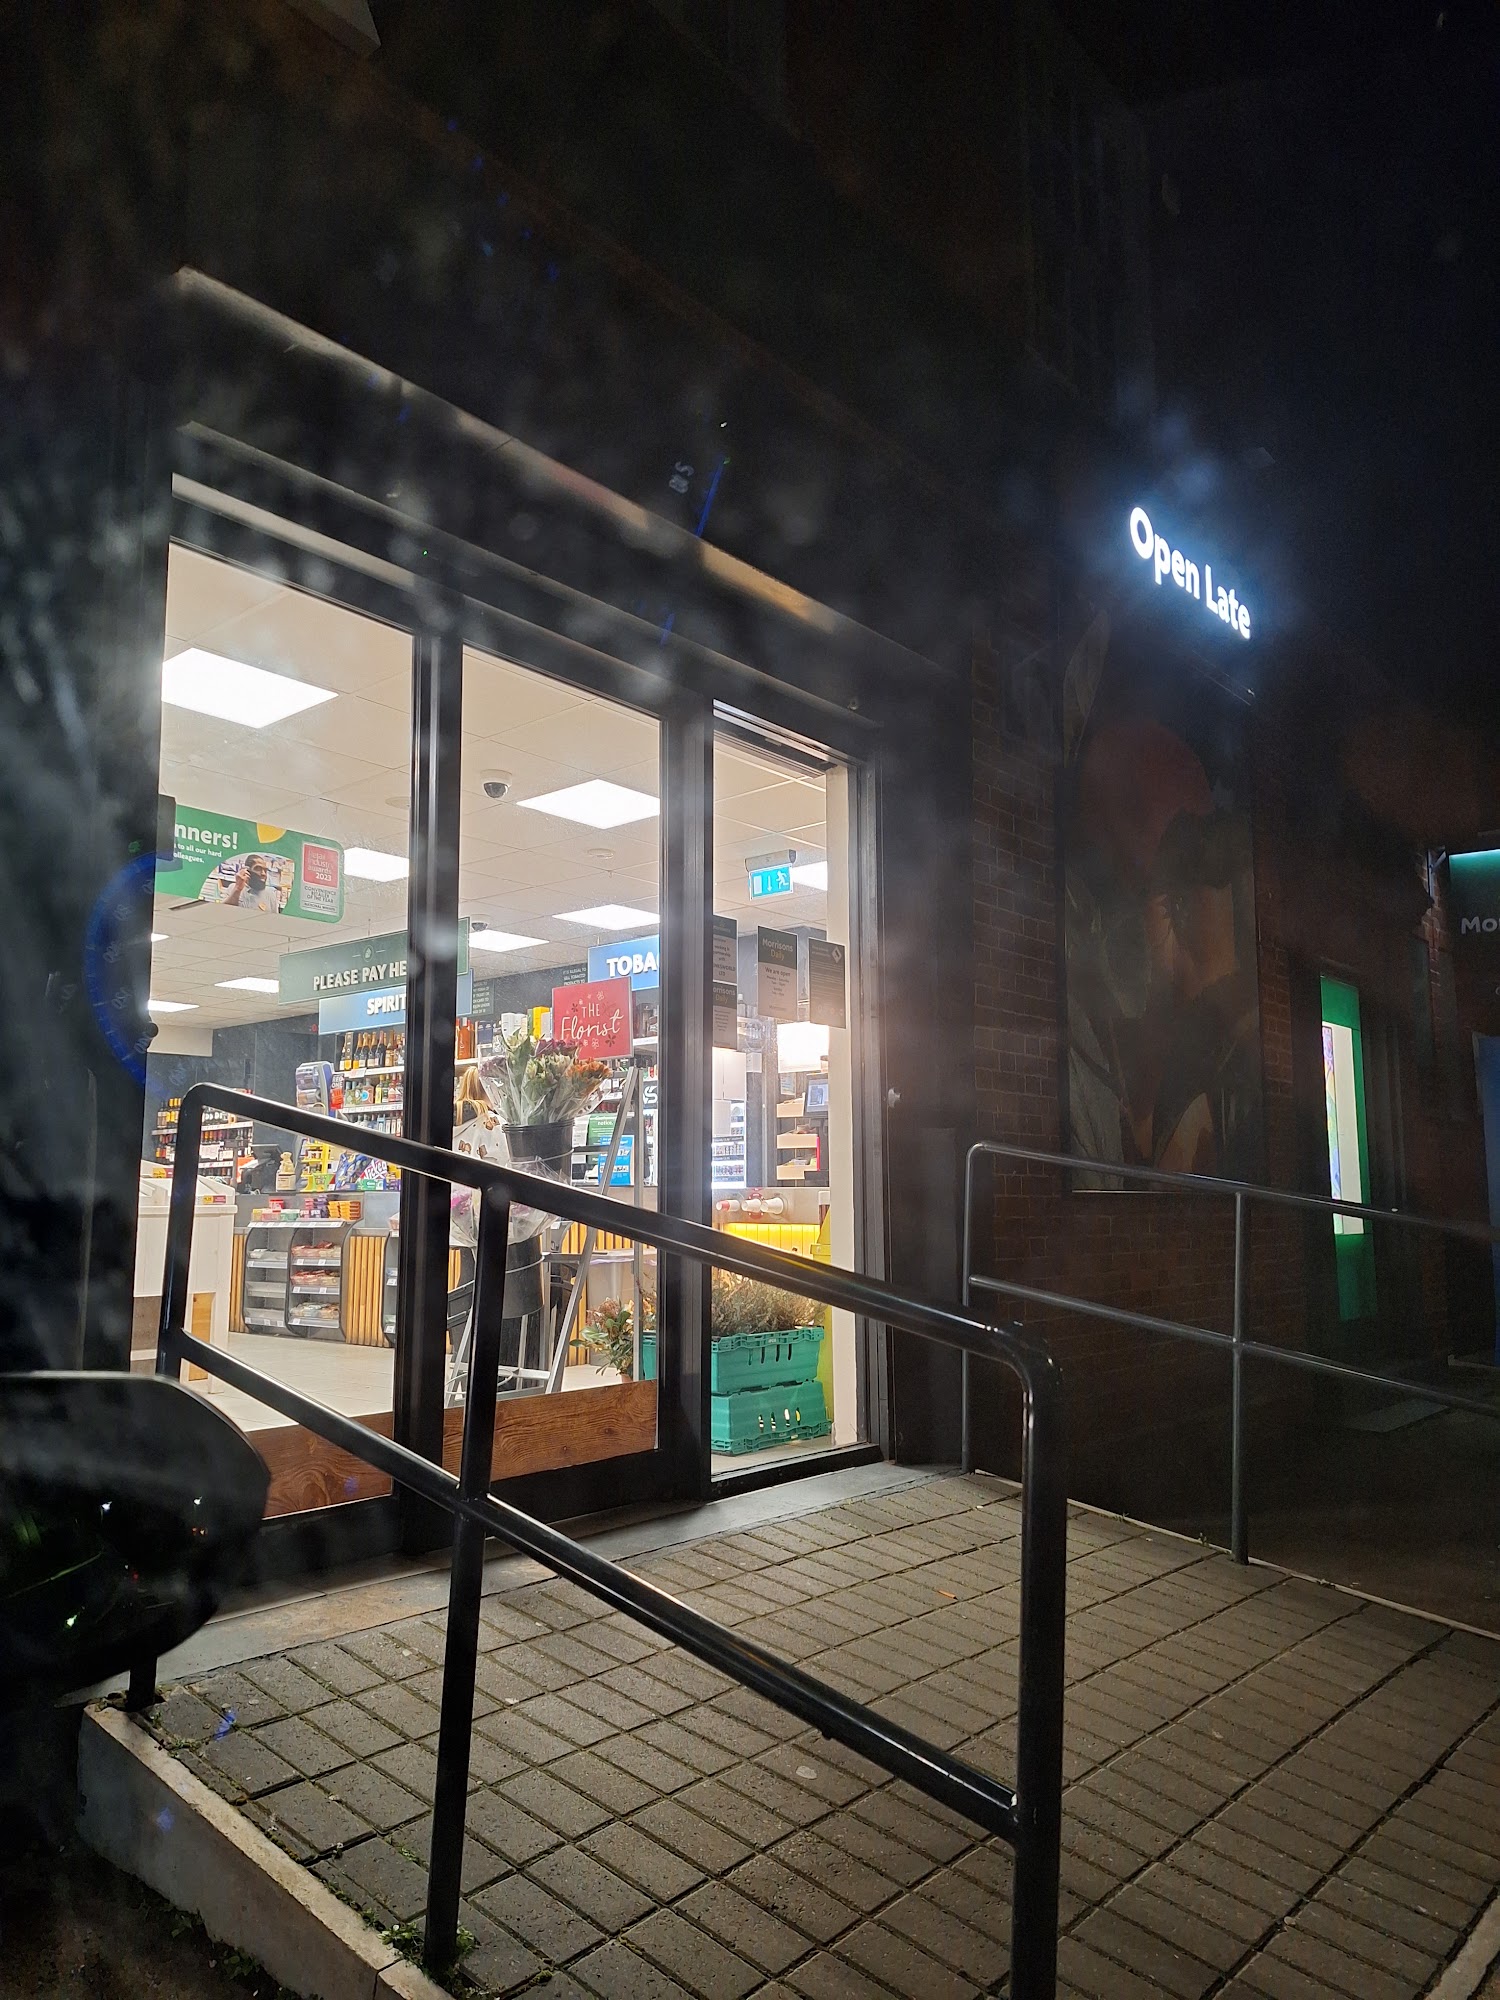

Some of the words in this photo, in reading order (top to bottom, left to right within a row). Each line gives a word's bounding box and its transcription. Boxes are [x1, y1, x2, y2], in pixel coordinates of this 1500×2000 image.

[1129, 506, 1201, 600] Open
[1205, 563, 1251, 640] Late
[207, 848, 222, 857] hard
[315, 872, 332, 882] 2023
[1461, 916, 1500, 935] Mo
[762, 938, 794, 952] Morrisons
[770, 949, 785, 961] Daily
[606, 952, 659, 977] TOBA
[764, 966, 772, 974] We
[313, 968, 359, 991] PLEASE
[361, 963, 388, 983] PAY
[715, 995, 729, 1005] Daily
[581, 1002, 601, 1018] THE
[560, 1008, 624, 1040] Florist
